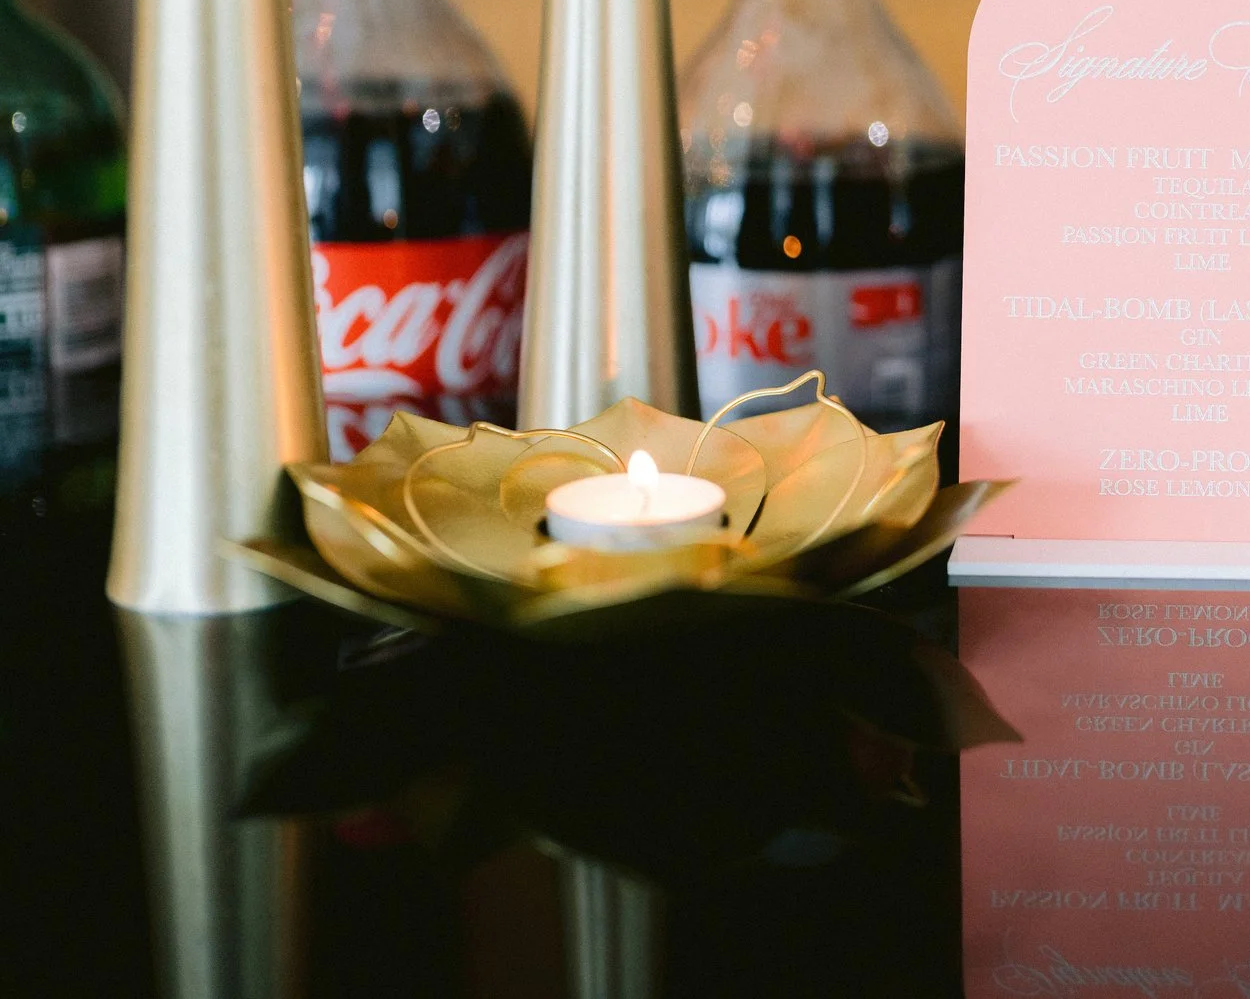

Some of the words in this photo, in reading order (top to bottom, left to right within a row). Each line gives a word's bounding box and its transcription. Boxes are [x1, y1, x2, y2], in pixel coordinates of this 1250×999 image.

[999, 5, 1208, 123] Signature
[994, 144, 1118, 169] PASSION
[1126, 146, 1214, 169] FRUIT
[1061, 225, 1157, 247] PASSION
[1164, 228, 1232, 245] FRUIT
[1174, 253, 1231, 272] LIME
[1002, 296, 1191, 321] TIDAL-BOMB
[1180, 329, 1221, 346] GIN
[1079, 352, 1158, 370] GREEN
[1063, 377, 1224, 396] MARASCHINO
[1171, 404, 1228, 424] LIME
[1099, 479, 1159, 496] ROSE
